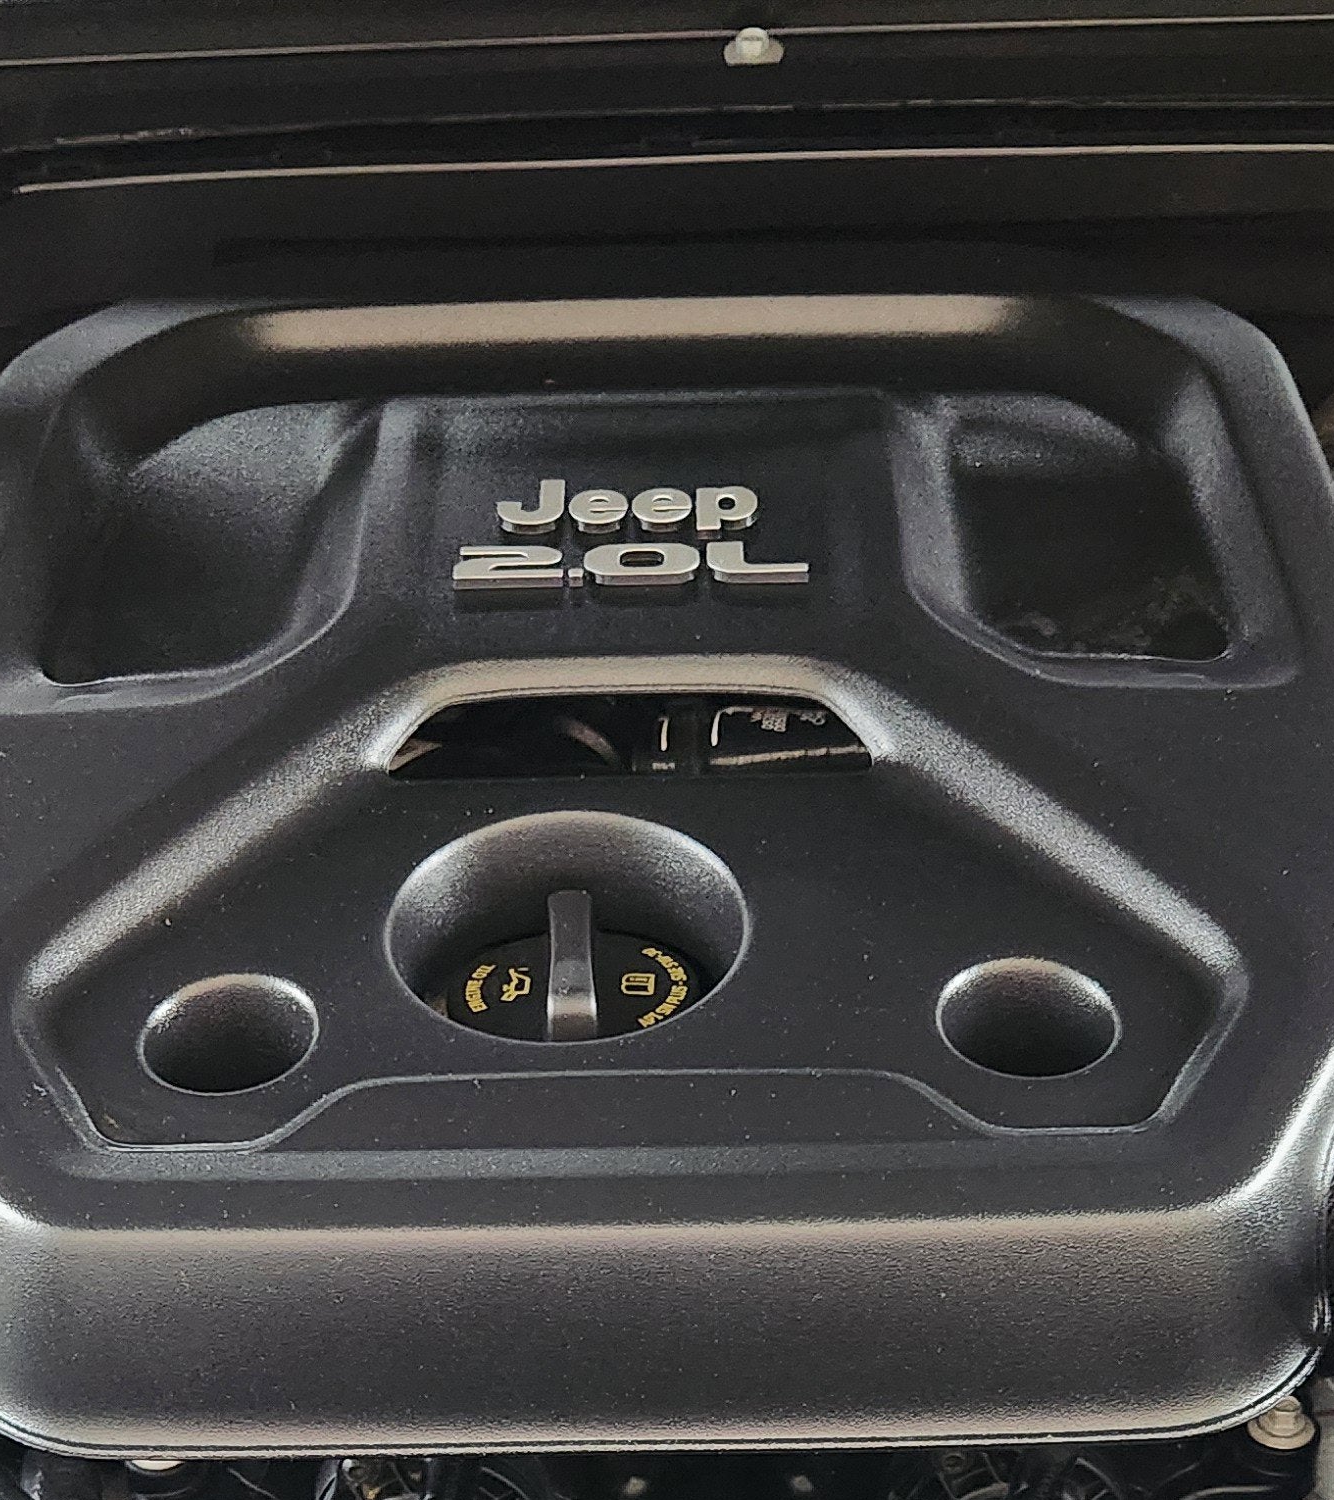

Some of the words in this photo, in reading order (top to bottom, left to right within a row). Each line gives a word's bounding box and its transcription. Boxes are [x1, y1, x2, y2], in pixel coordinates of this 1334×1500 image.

[496, 479, 758, 537] Jeep
[453, 543, 809, 590] 2.0L
[471, 963, 498, 980] OIL
[464, 978, 488, 1013] ENGINE
